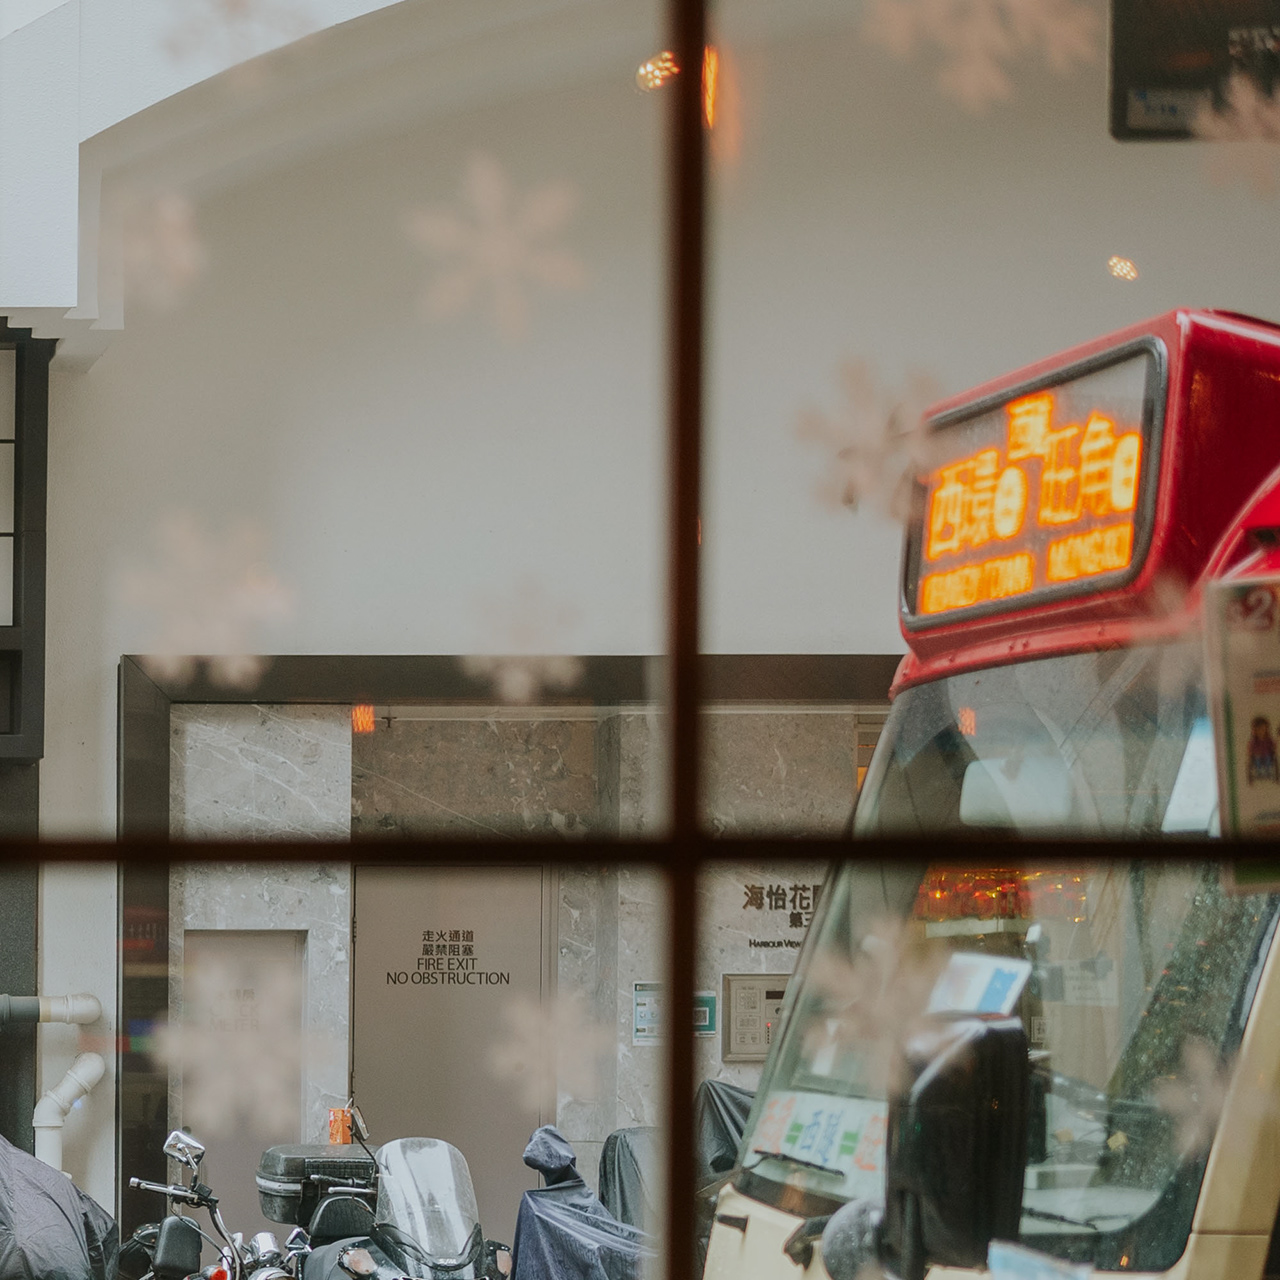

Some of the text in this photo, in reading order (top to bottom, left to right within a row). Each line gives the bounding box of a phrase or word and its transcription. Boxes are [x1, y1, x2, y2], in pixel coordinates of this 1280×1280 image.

[422, 930, 474, 942] 走火通道
[422, 944, 474, 956] 嚴禁阻塞
[417, 958, 478, 970] FIRE EXIT
[386, 972, 510, 985] NO OBSTRUCTION
